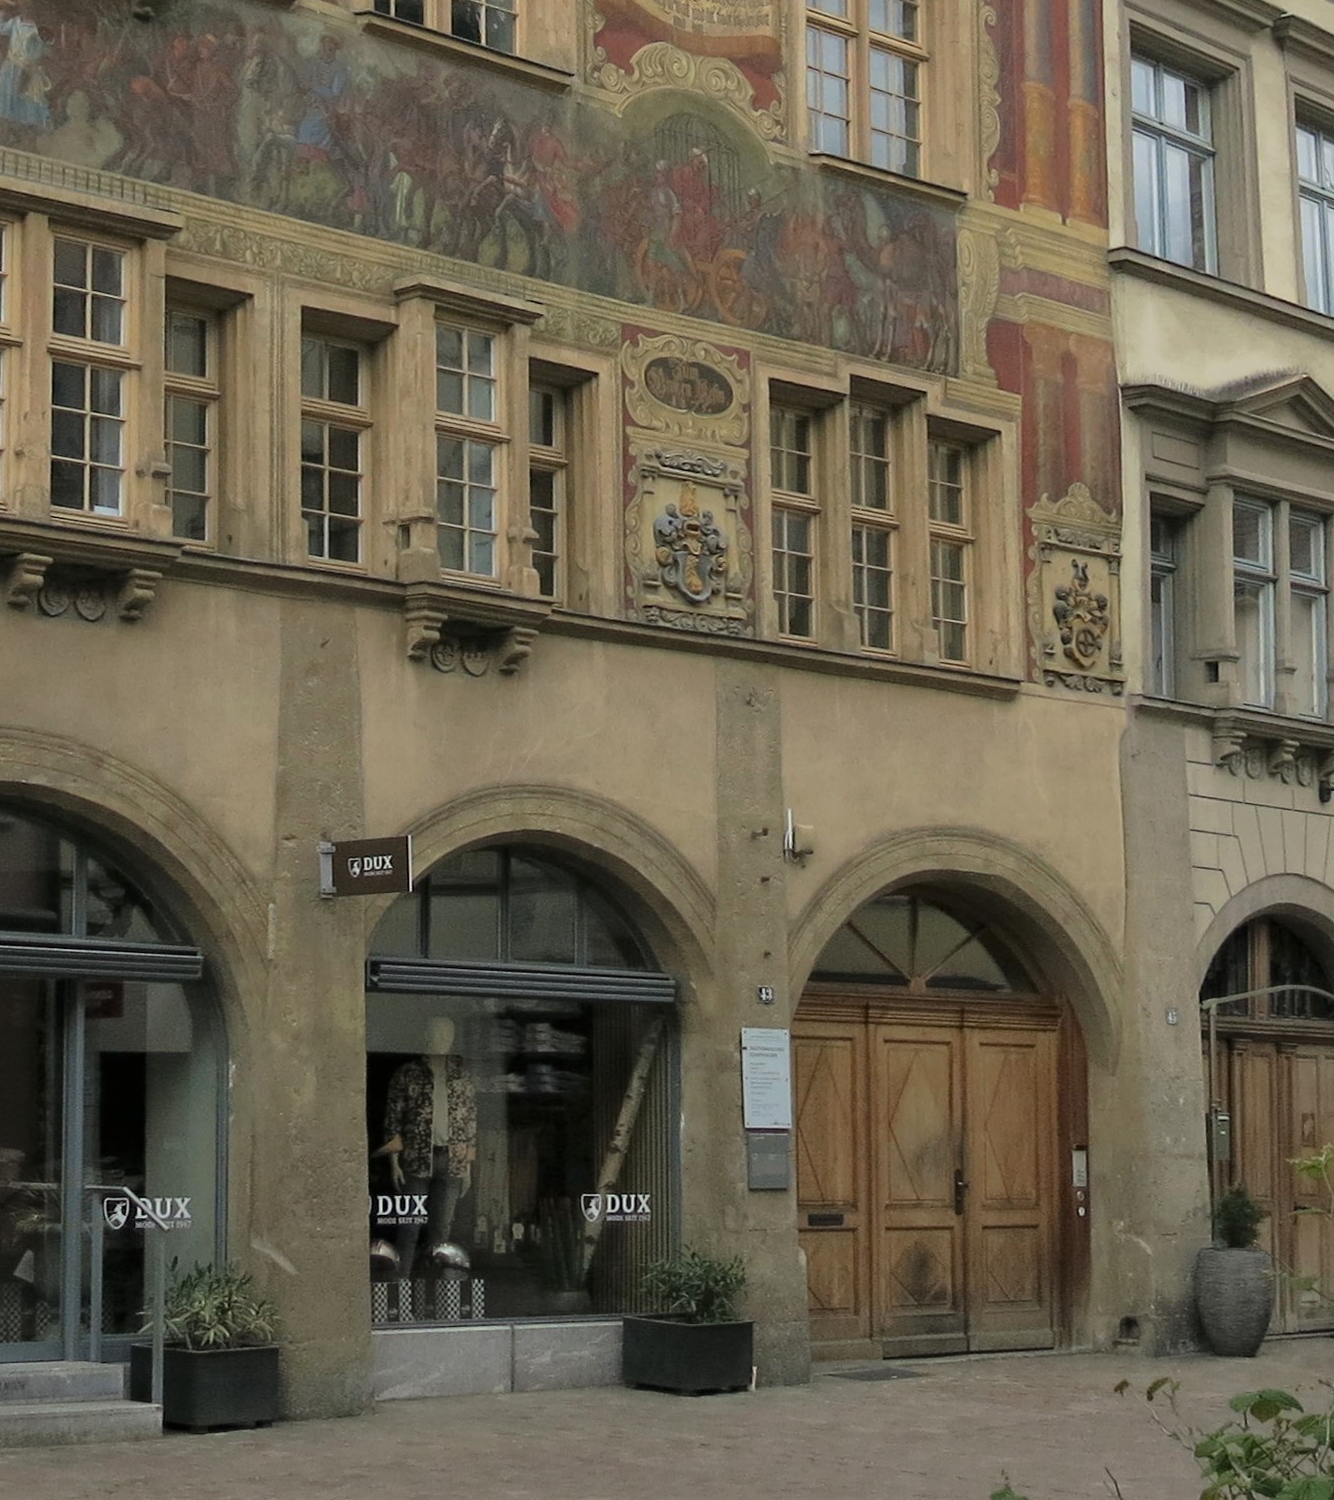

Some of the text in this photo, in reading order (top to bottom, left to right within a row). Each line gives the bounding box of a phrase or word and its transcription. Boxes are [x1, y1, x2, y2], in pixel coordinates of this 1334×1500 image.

[363, 855, 393, 871] DUX
[135, 1197, 192, 1219] DUX
[376, 1195, 428, 1216] DUX
[606, 1194, 651, 1214] DUX
